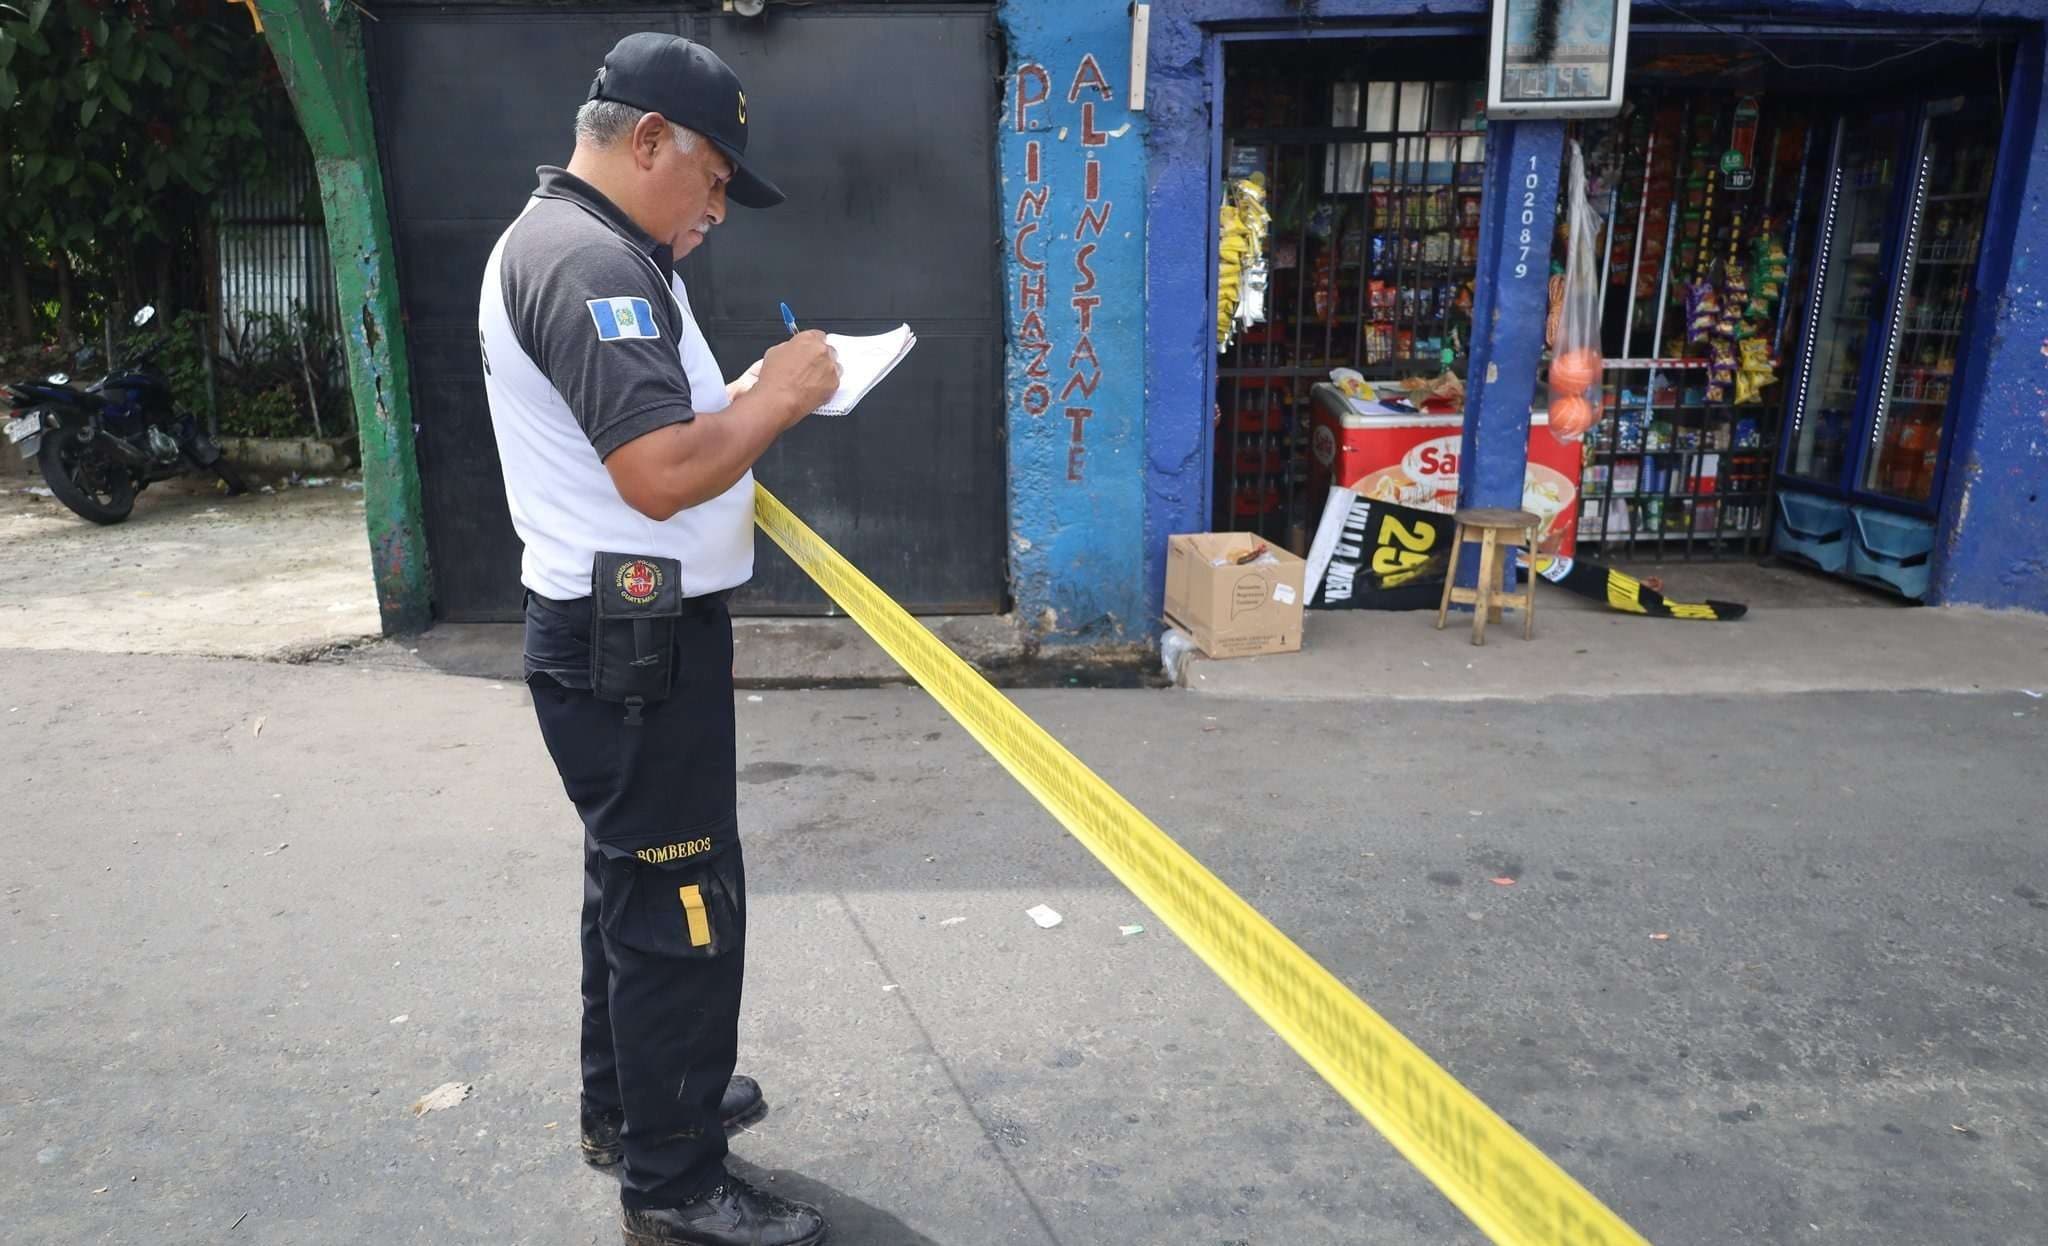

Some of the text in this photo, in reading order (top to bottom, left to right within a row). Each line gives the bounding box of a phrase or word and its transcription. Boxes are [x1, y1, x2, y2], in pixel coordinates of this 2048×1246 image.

[1514, 155, 1538, 279] 1020879
[1418, 447, 1460, 476] Sa
[635, 837, 712, 864] BOMBEROS
